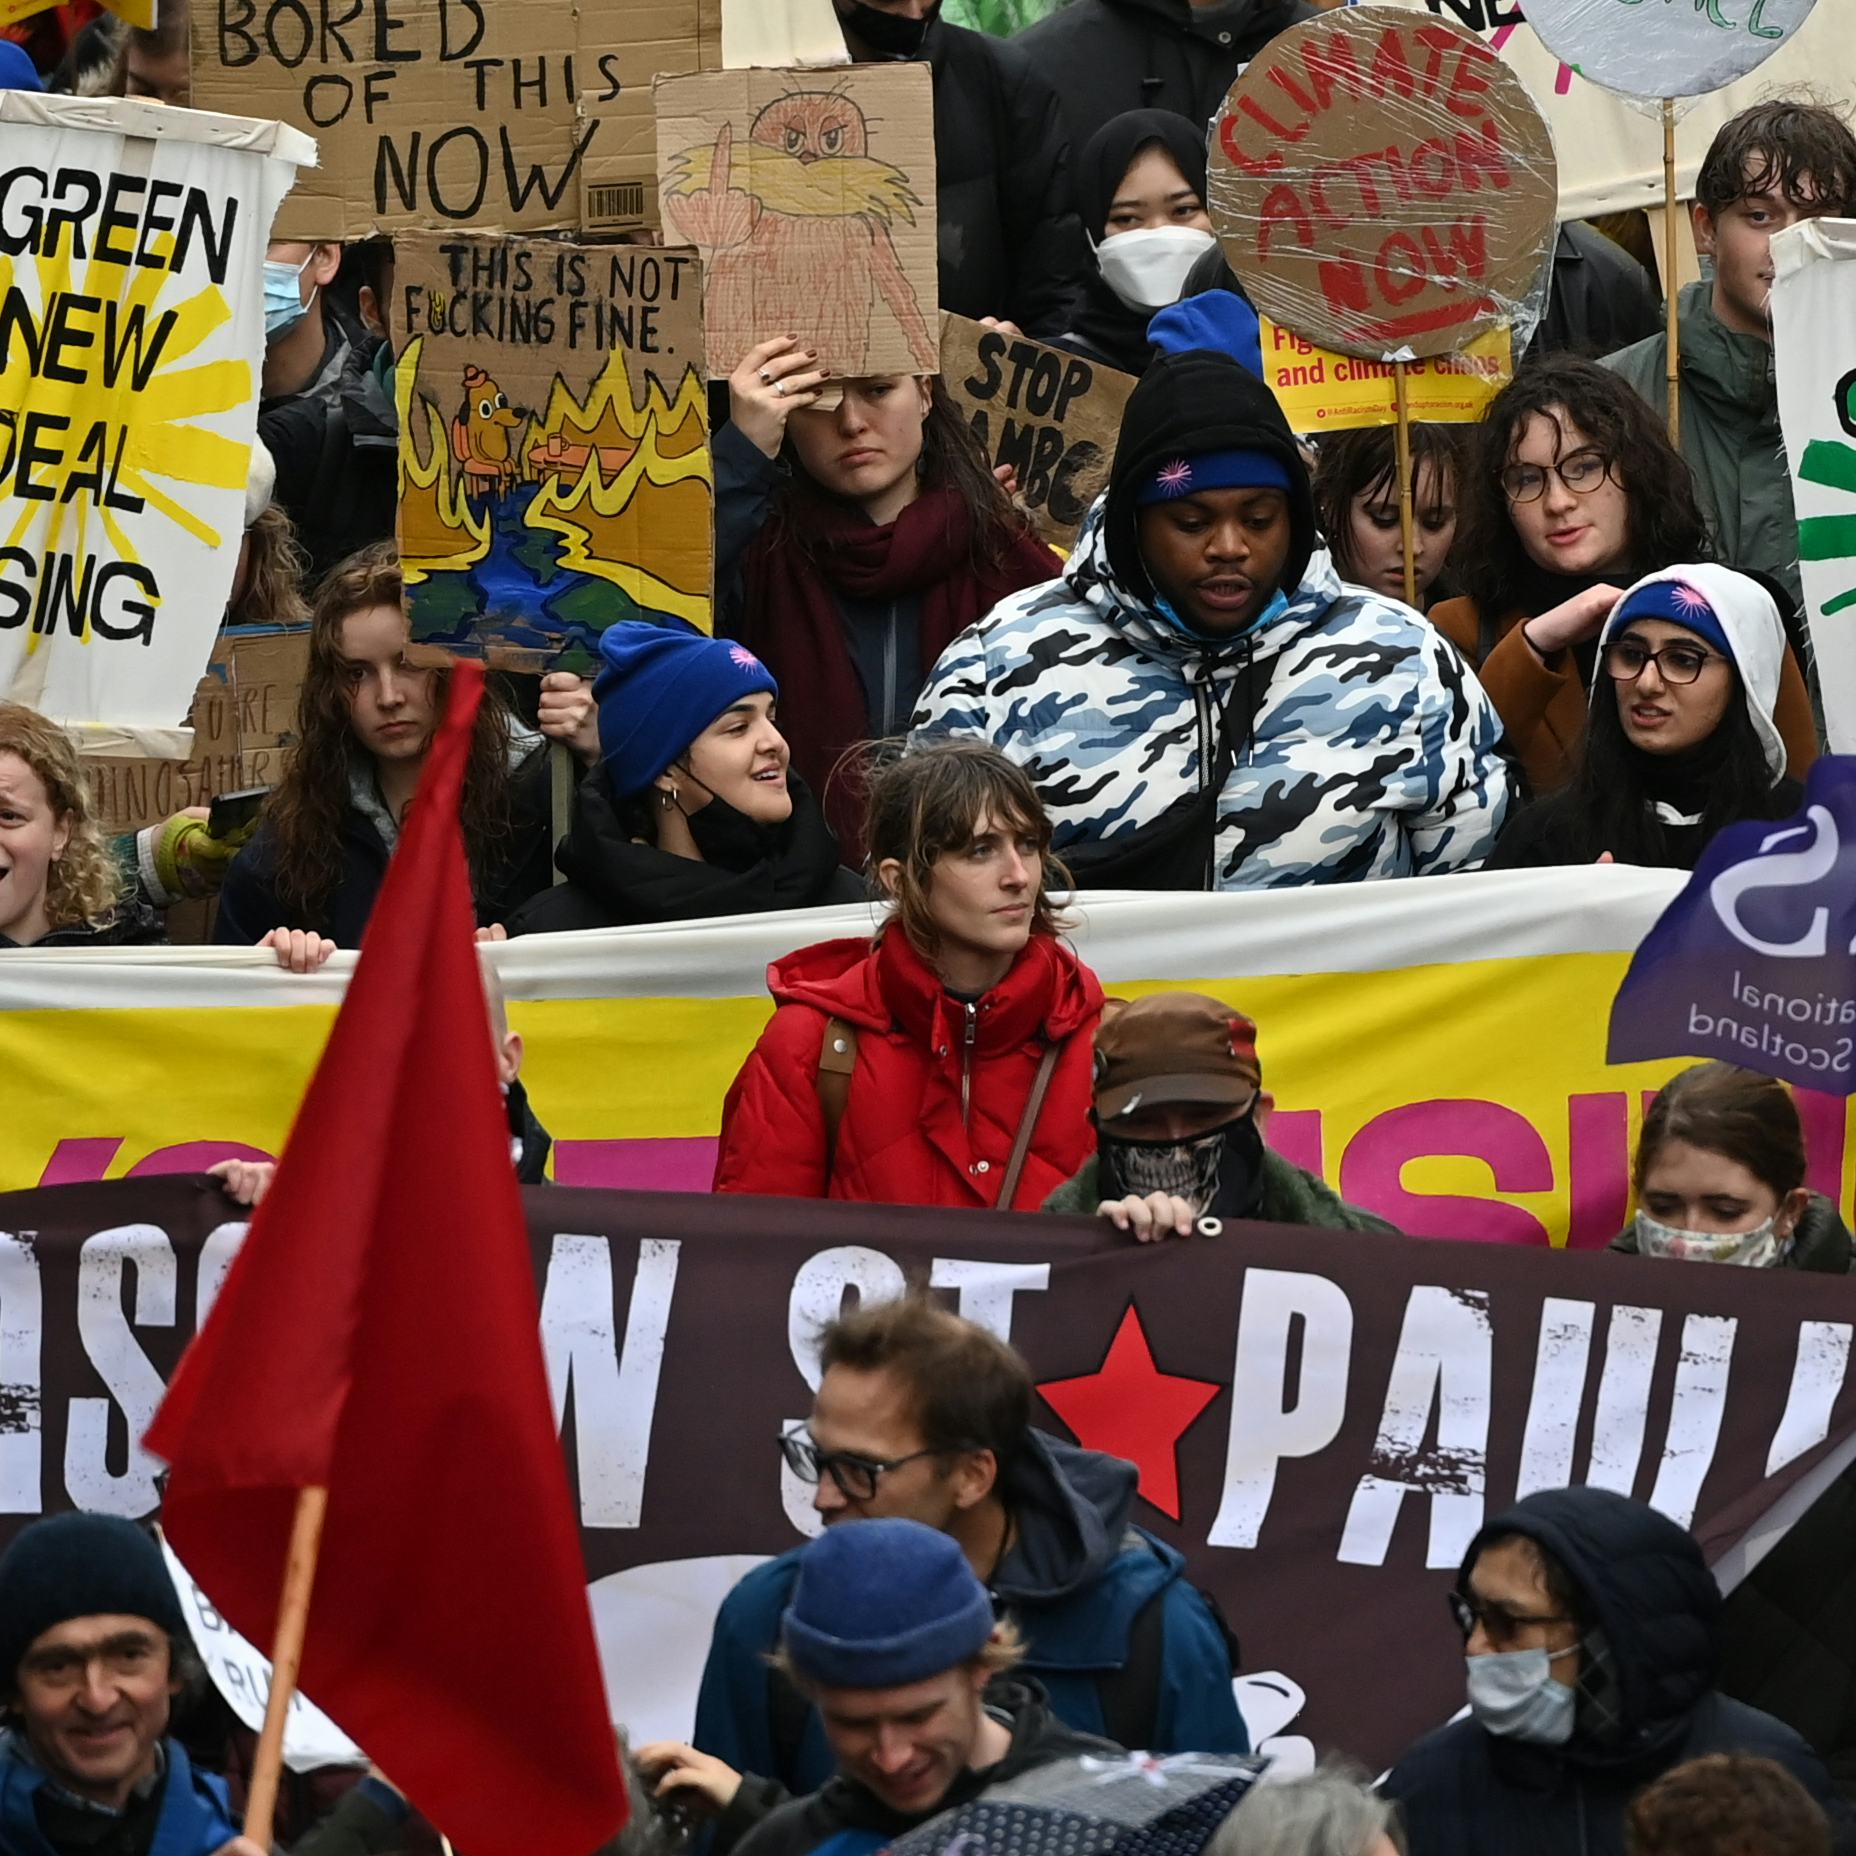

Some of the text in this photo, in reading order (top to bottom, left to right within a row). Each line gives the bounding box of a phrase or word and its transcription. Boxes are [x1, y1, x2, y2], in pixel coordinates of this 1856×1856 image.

[303, 53, 621, 129] OF THIS
[1218, 25, 1499, 179] CLIMATE
[375, 118, 602, 221] NOW
[1256, 118, 1510, 262] ACTION
[439, 243, 690, 303] THIS IS NOT
[1318, 224, 1489, 319] NOW
[405, 284, 677, 356] FUCKING FINE.
[964, 332, 1092, 423] STOP
[1276, 358, 1324, 387] and
